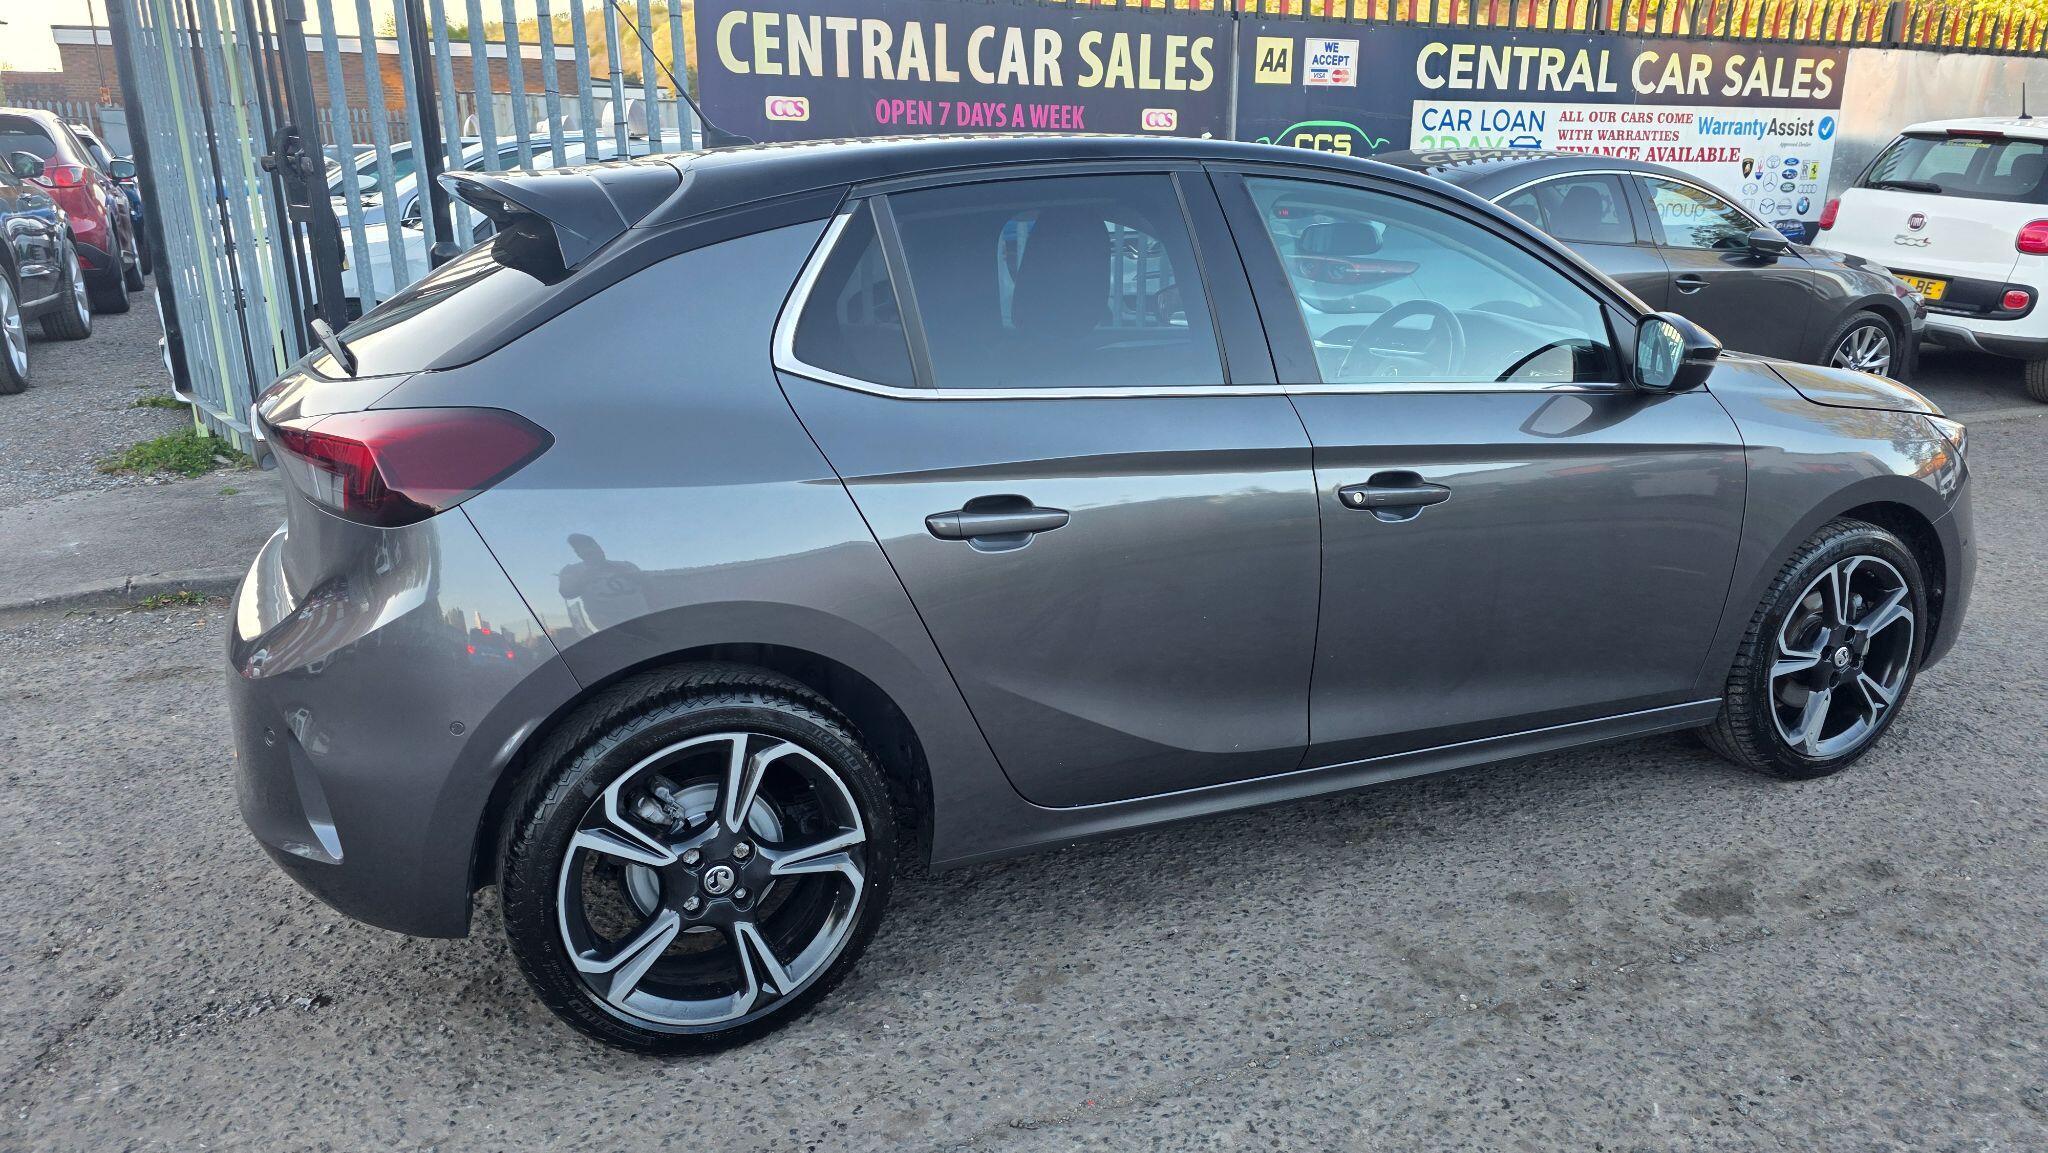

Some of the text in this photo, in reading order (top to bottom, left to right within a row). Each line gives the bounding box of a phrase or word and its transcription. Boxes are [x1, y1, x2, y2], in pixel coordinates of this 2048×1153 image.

[716, 10, 1215, 92] CENTRAL CAR SALES
[1324, 42, 1340, 53] WE
[1259, 48, 1287, 73] AA
[1312, 54, 1350, 66] ACCEPT
[1416, 42, 1836, 100] CENTRAL CAR SALES
[770, 100, 805, 118] CCS
[875, 99, 1085, 130] OPEN 7 DAYS A WEEK
[1559, 111, 1694, 124] ALL OUR CARS COME
[1145, 112, 1173, 129] CCS
[1421, 108, 1546, 132] CAR LOAN
[1294, 133, 1352, 156] CCS
[1558, 129, 1680, 142] WITH WARRANTIES
[1644, 147, 1741, 163] AVAILABLE
